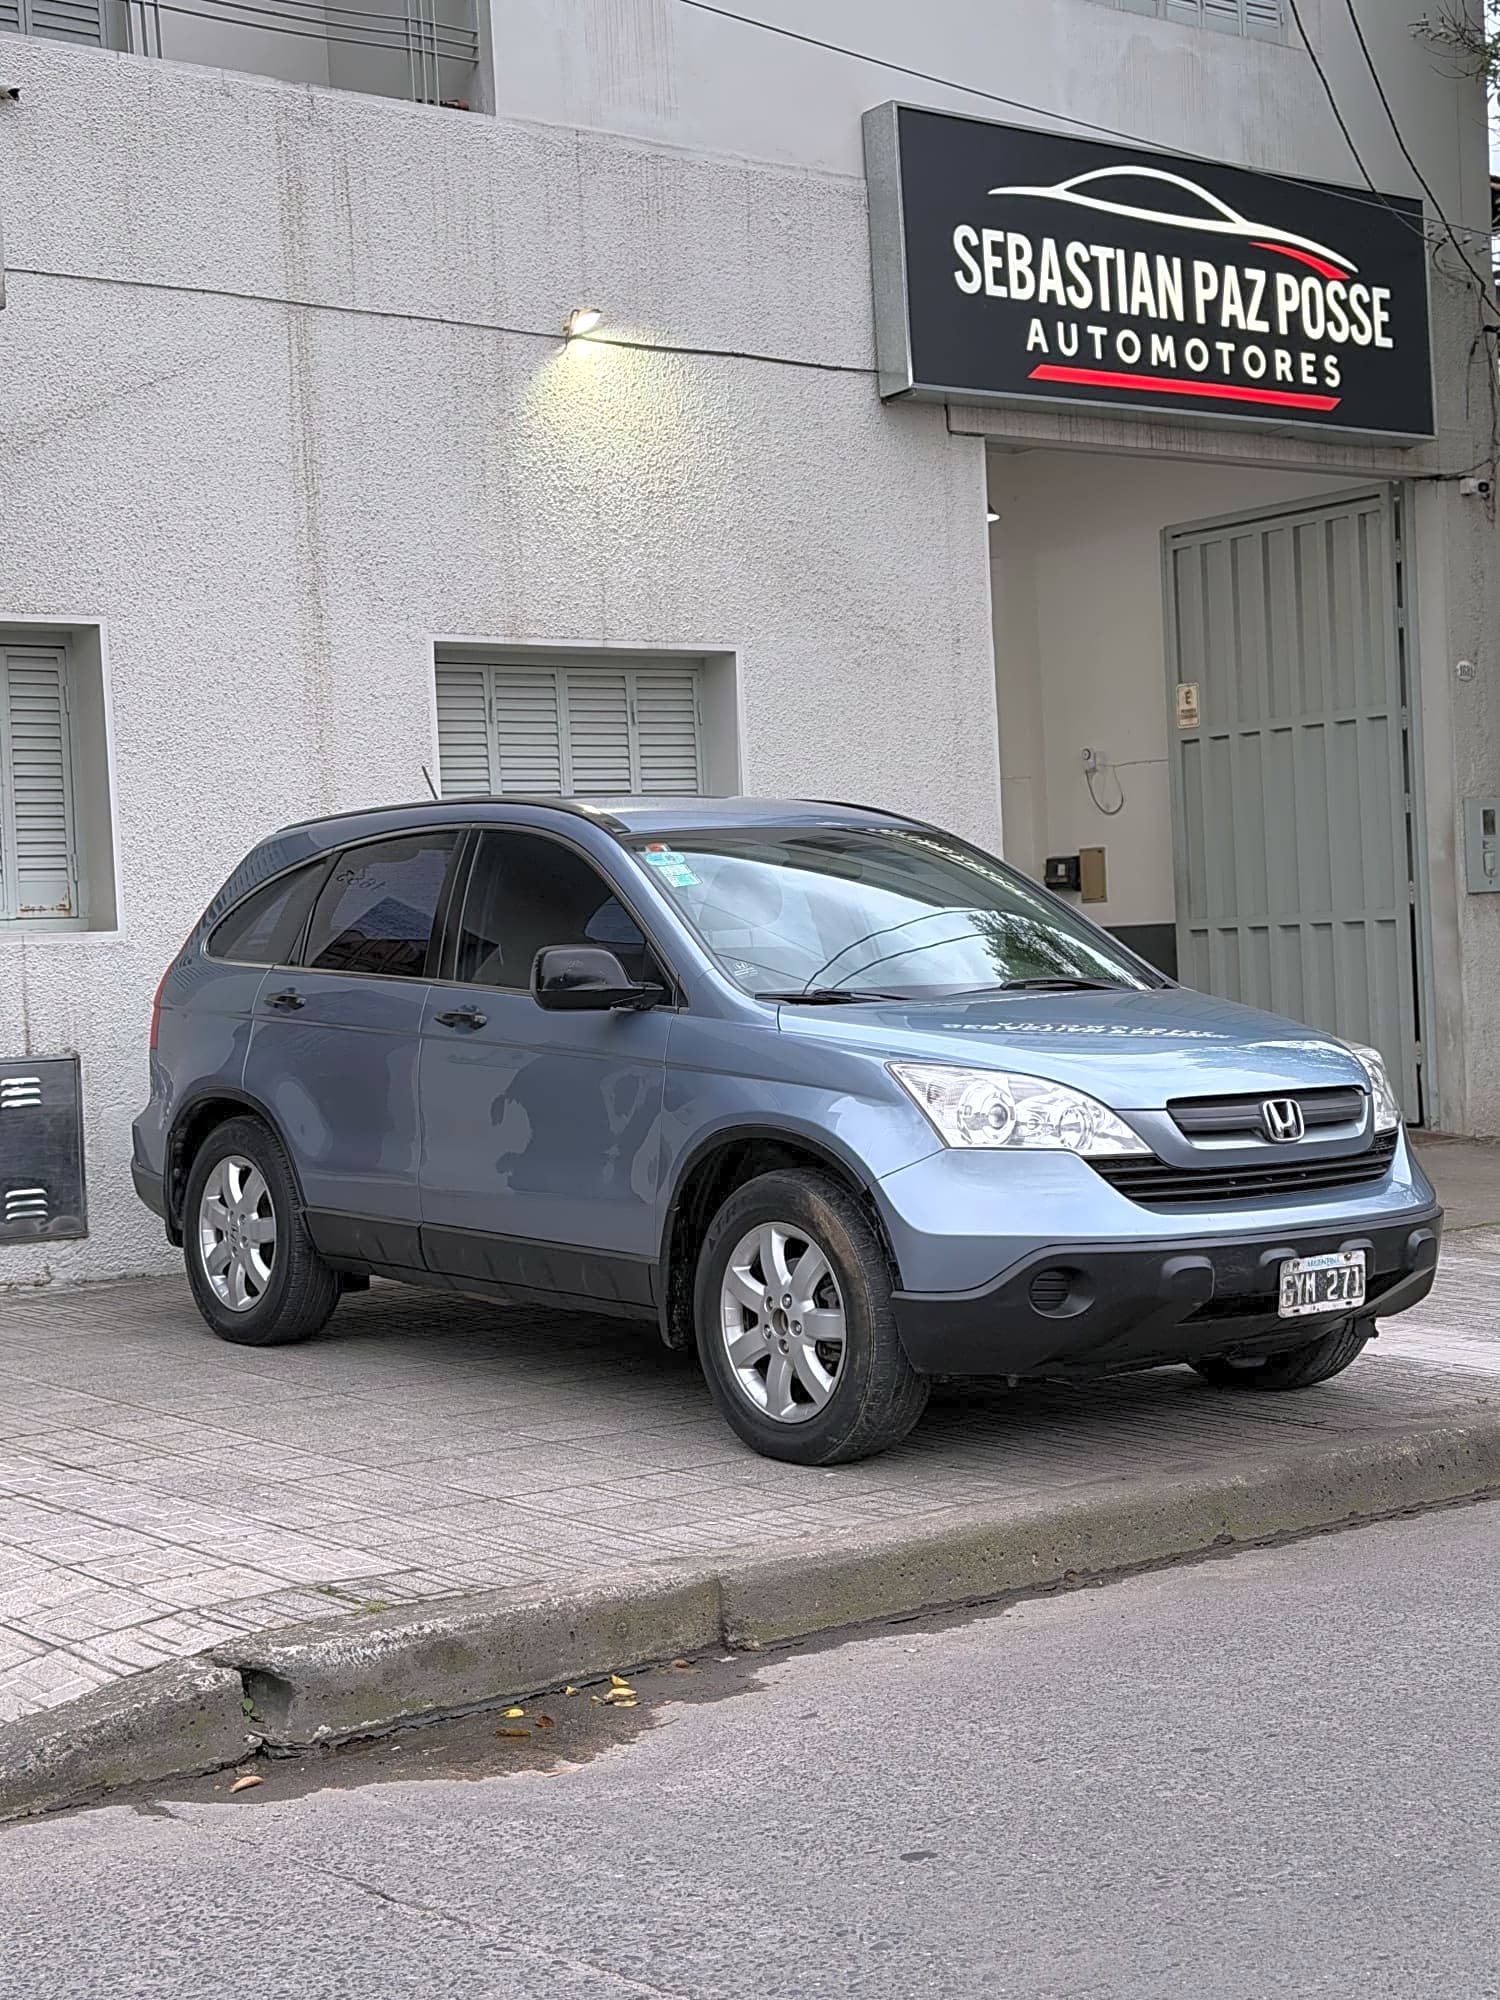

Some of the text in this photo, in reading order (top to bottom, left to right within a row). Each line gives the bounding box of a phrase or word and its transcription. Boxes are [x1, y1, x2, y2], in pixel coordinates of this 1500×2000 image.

[953, 224, 1394, 349] SEBASTIAN PAZ POSSE
[1026, 318, 1341, 388] AUTOMOTORES
[1326, 1266, 1361, 1300] 271
